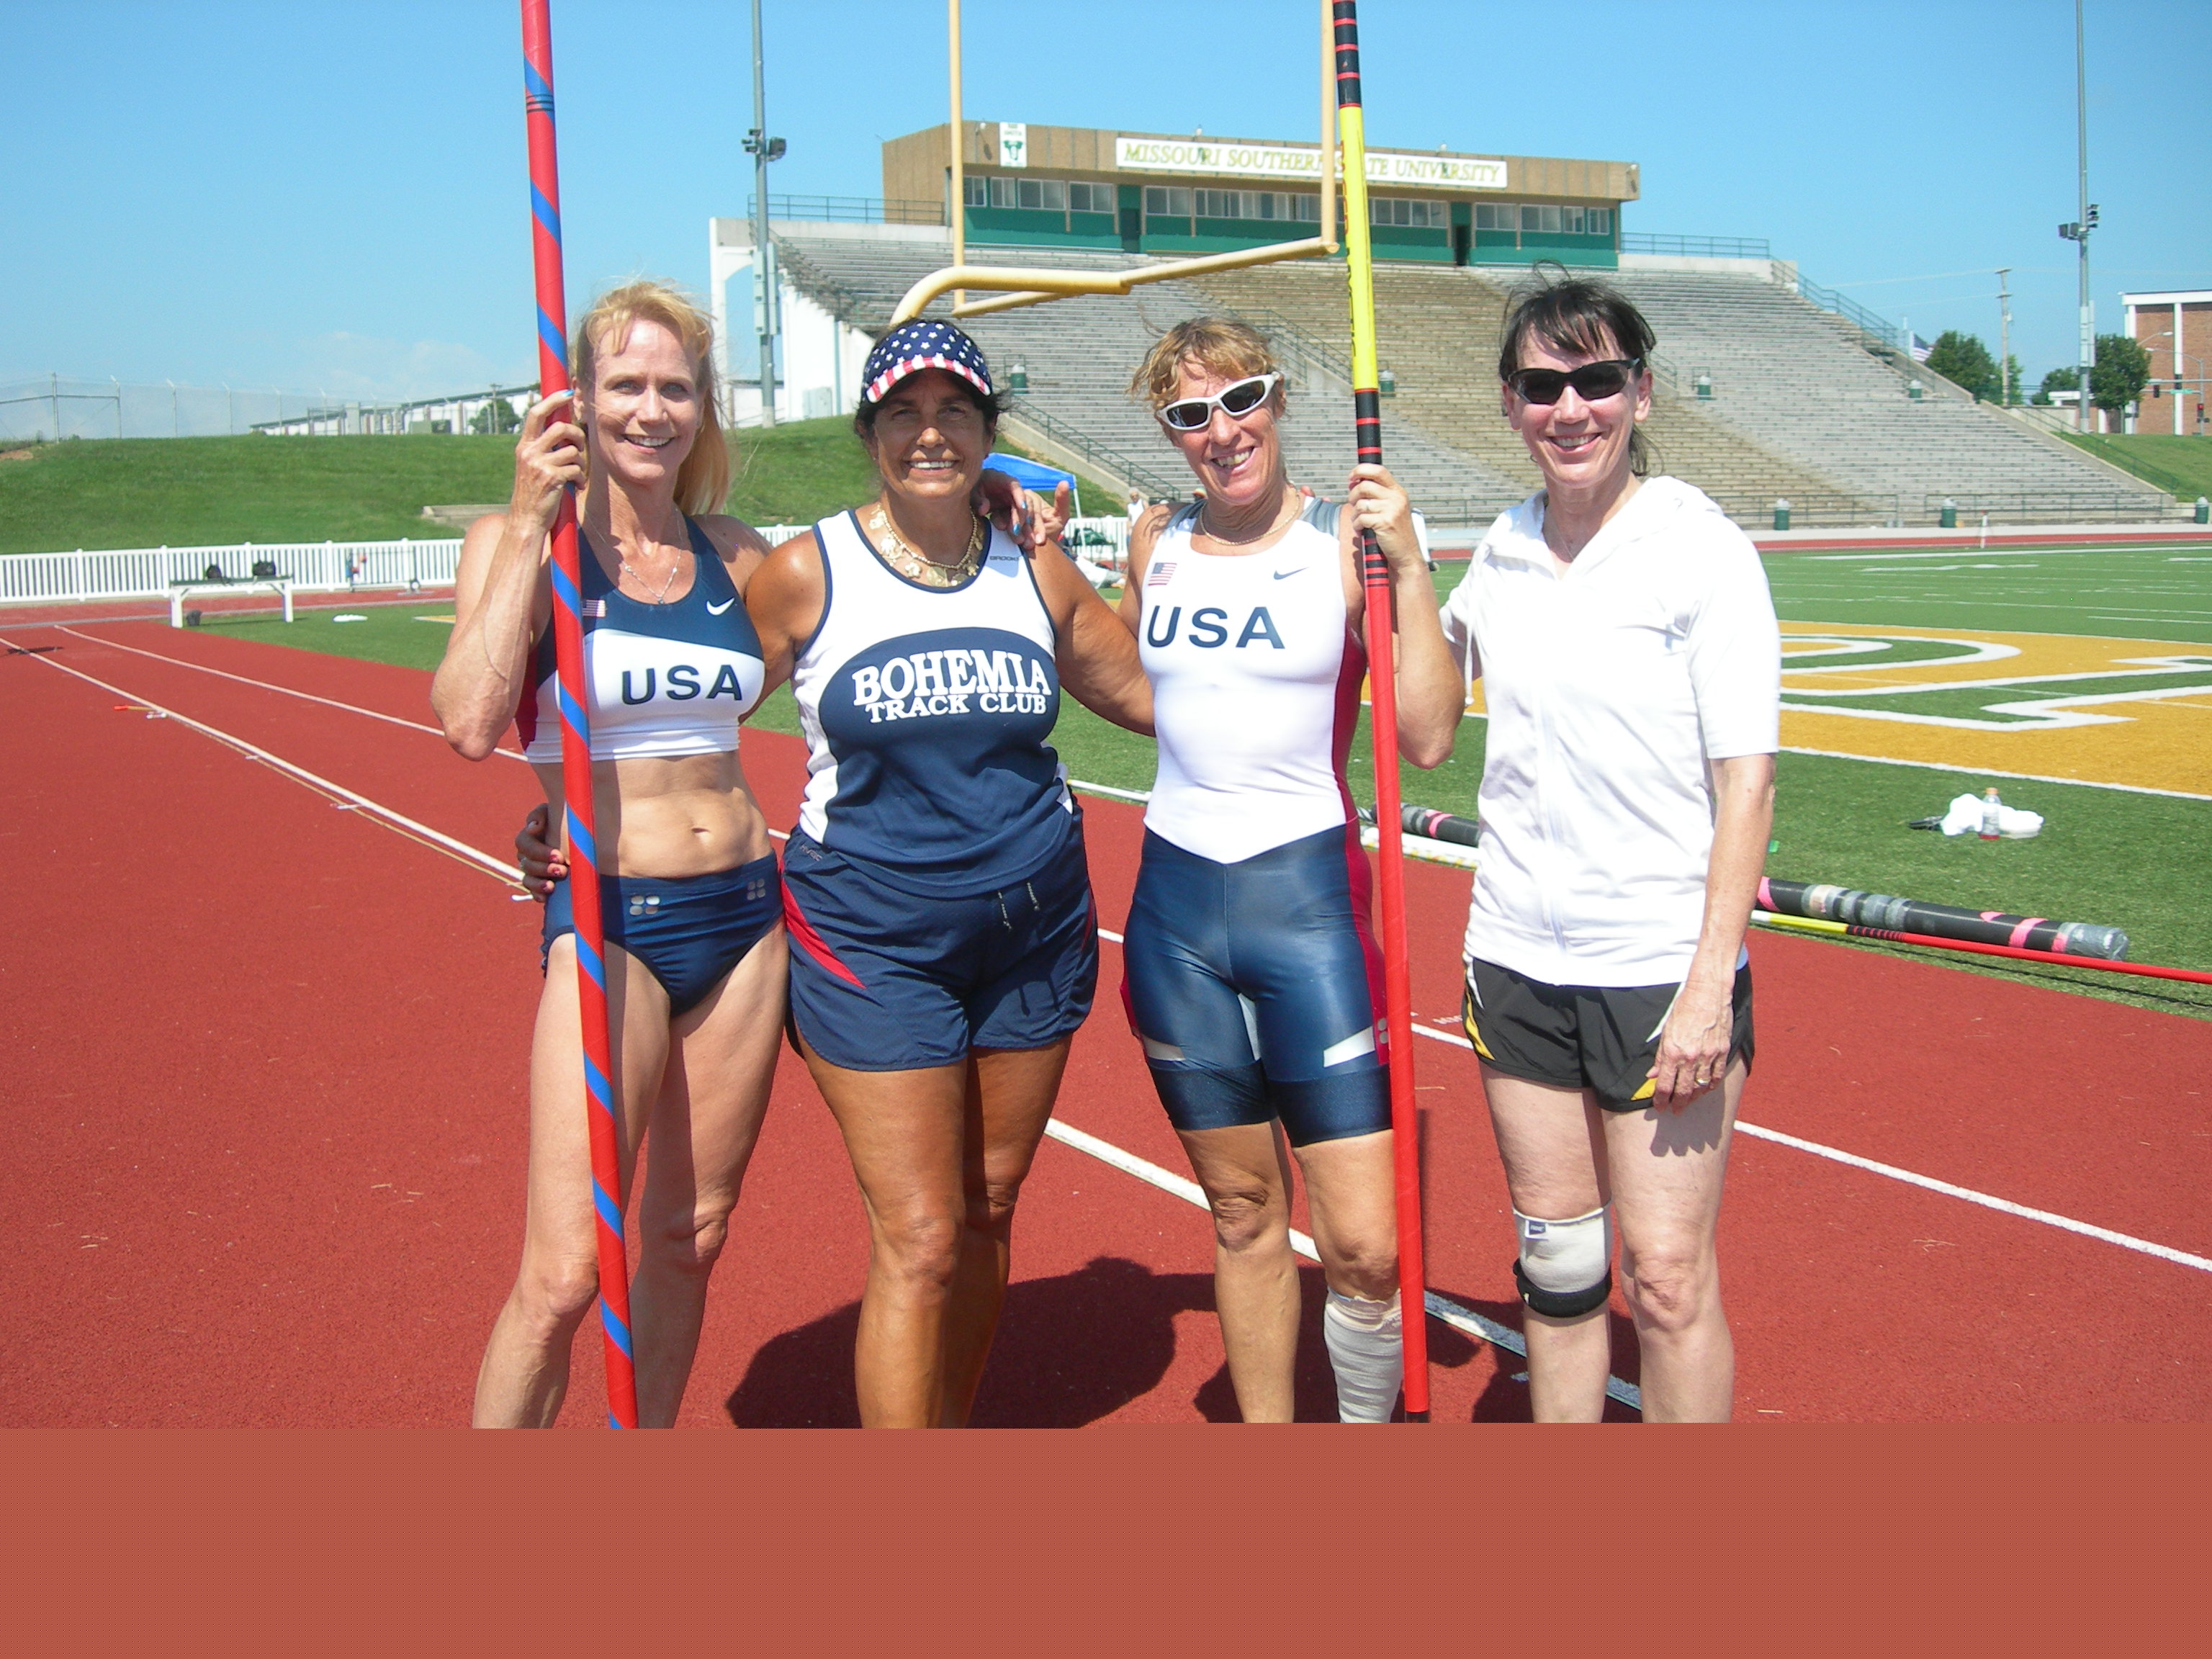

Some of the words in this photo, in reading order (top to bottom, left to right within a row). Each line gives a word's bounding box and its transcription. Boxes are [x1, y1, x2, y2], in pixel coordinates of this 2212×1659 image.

[1124, 143, 1221, 166] MISSOURI
[1333, 155, 1390, 176] STE
[1395, 159, 1501, 182] UNIVERSITY
[1147, 605, 1285, 649] USA
[621, 665, 743, 706] USA
[852, 649, 1051, 706] BOHEMIA
[865, 693, 971, 723] TRACK
[979, 692, 1047, 714] CLUB
